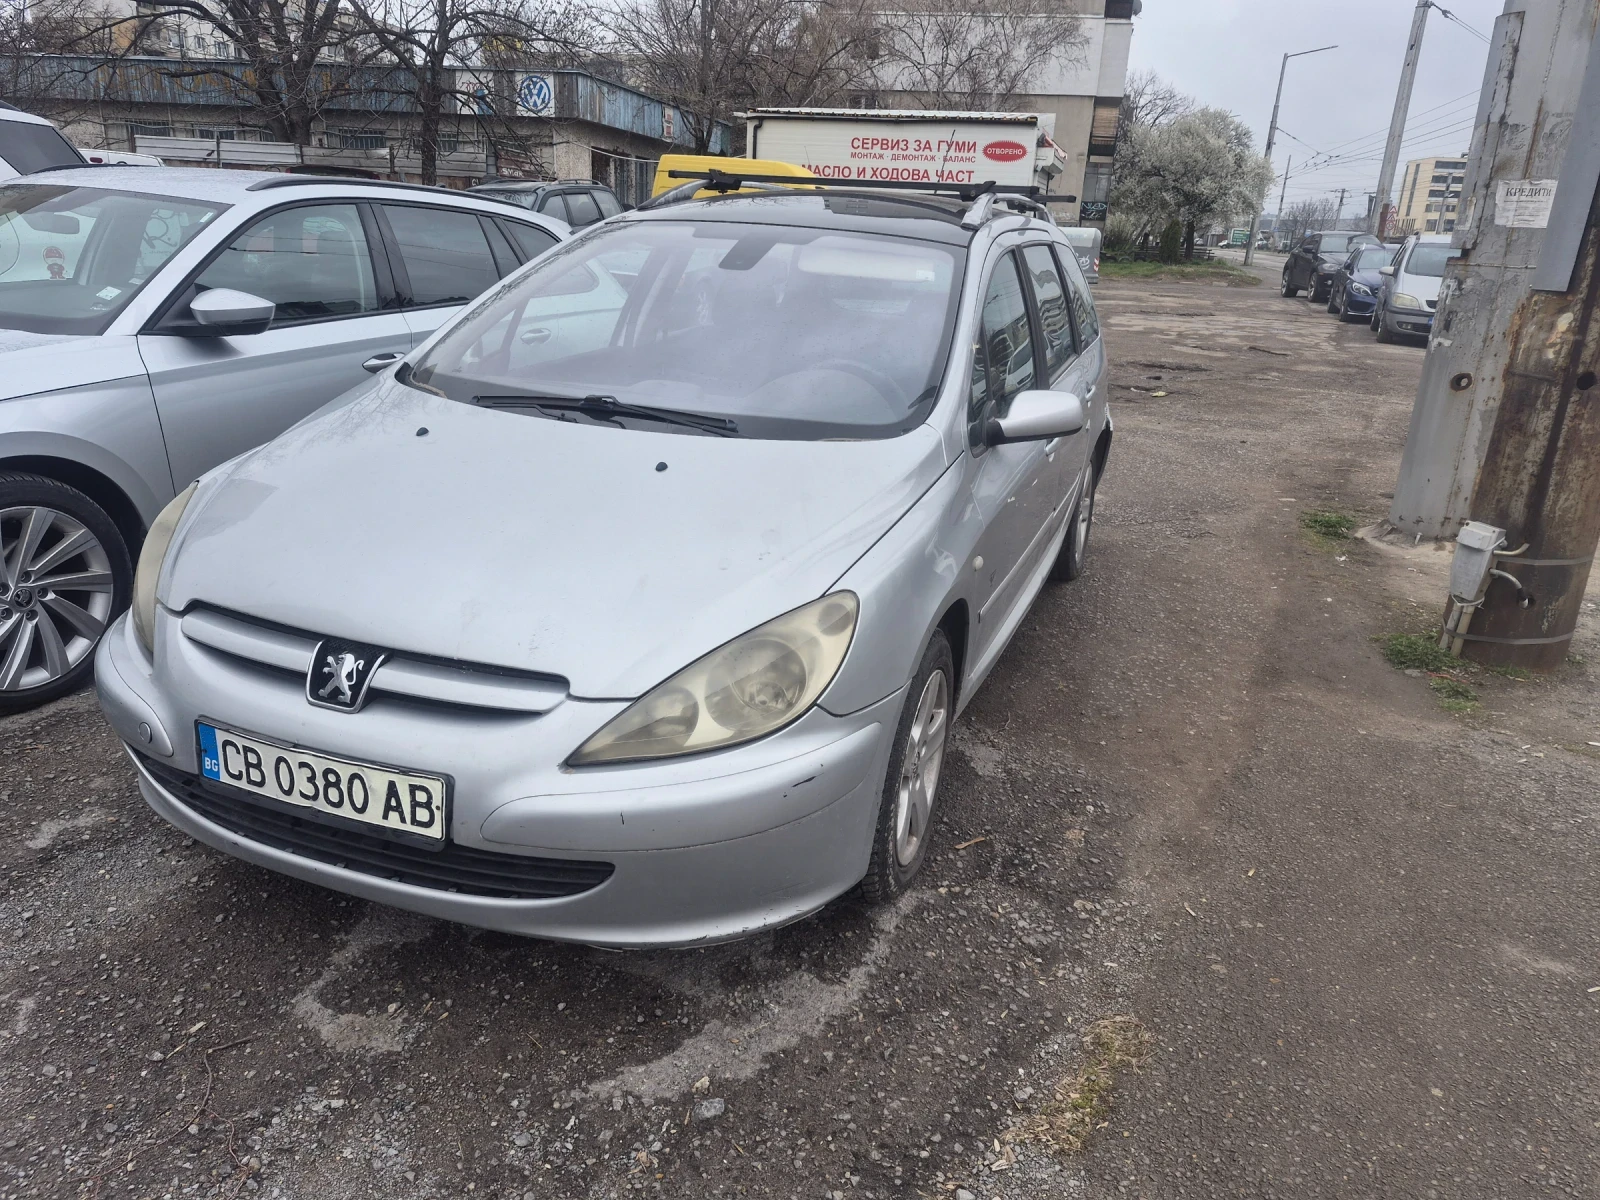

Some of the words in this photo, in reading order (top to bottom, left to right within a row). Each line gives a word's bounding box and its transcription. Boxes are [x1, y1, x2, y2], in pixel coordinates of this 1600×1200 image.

[851, 137, 909, 152] СЕРВИЗ
[913, 139, 932, 152] ЗА
[937, 140, 977, 154] ГУМИ
[986, 147, 1023, 155] ОТВОРЕНО
[850, 152, 885, 160] МОНТАЖ
[890, 154, 936, 162] ДЕМОНТАЖ
[943, 155, 976, 163] БАЛАНС
[857, 167, 866, 178] И
[870, 167, 930, 182] ХОДОВА
[935, 169, 975, 183] ЧАСТ
[1505, 187, 1552, 198] КРЕДИТИ
[204, 757, 219, 773] BG
[221, 739, 266, 788] CB
[274, 755, 370, 815] 0380
[381, 779, 436, 829] AB
